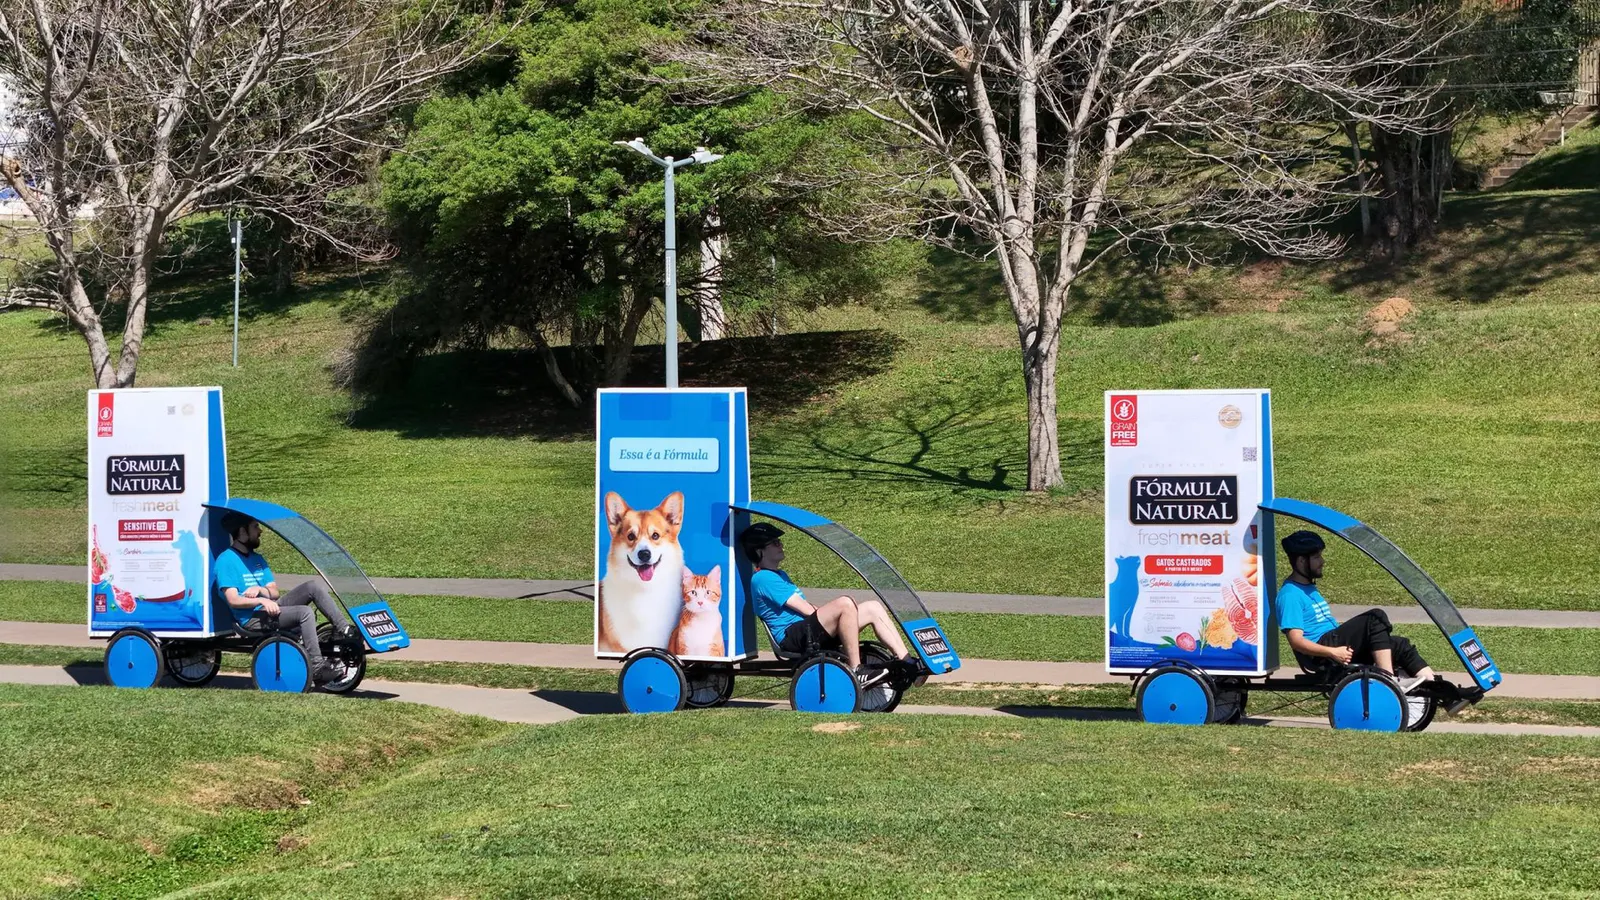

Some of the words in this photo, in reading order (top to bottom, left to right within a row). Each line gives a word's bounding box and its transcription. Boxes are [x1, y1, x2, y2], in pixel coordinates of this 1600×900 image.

[1112, 422, 1136, 430] GRAIN
[1112, 430, 1136, 439] FREE
[619, 448, 643, 460] Essa
[646, 448, 653, 460] é
[653, 451, 661, 460] a
[663, 448, 709, 460] Fórmula
[110, 457, 181, 473] FÓRMULA
[110, 476, 181, 492] NATURAL
[1135, 478, 1232, 497] FÓRMULA
[1135, 502, 1233, 520] NATURAL
[123, 522, 157, 531] SENSITIVE
[1156, 558, 1175, 567] GATOS
[1175, 558, 1212, 567] CASTRADOS
[359, 611, 391, 625] FÓRMULA
[366, 621, 399, 637] NATURAL
